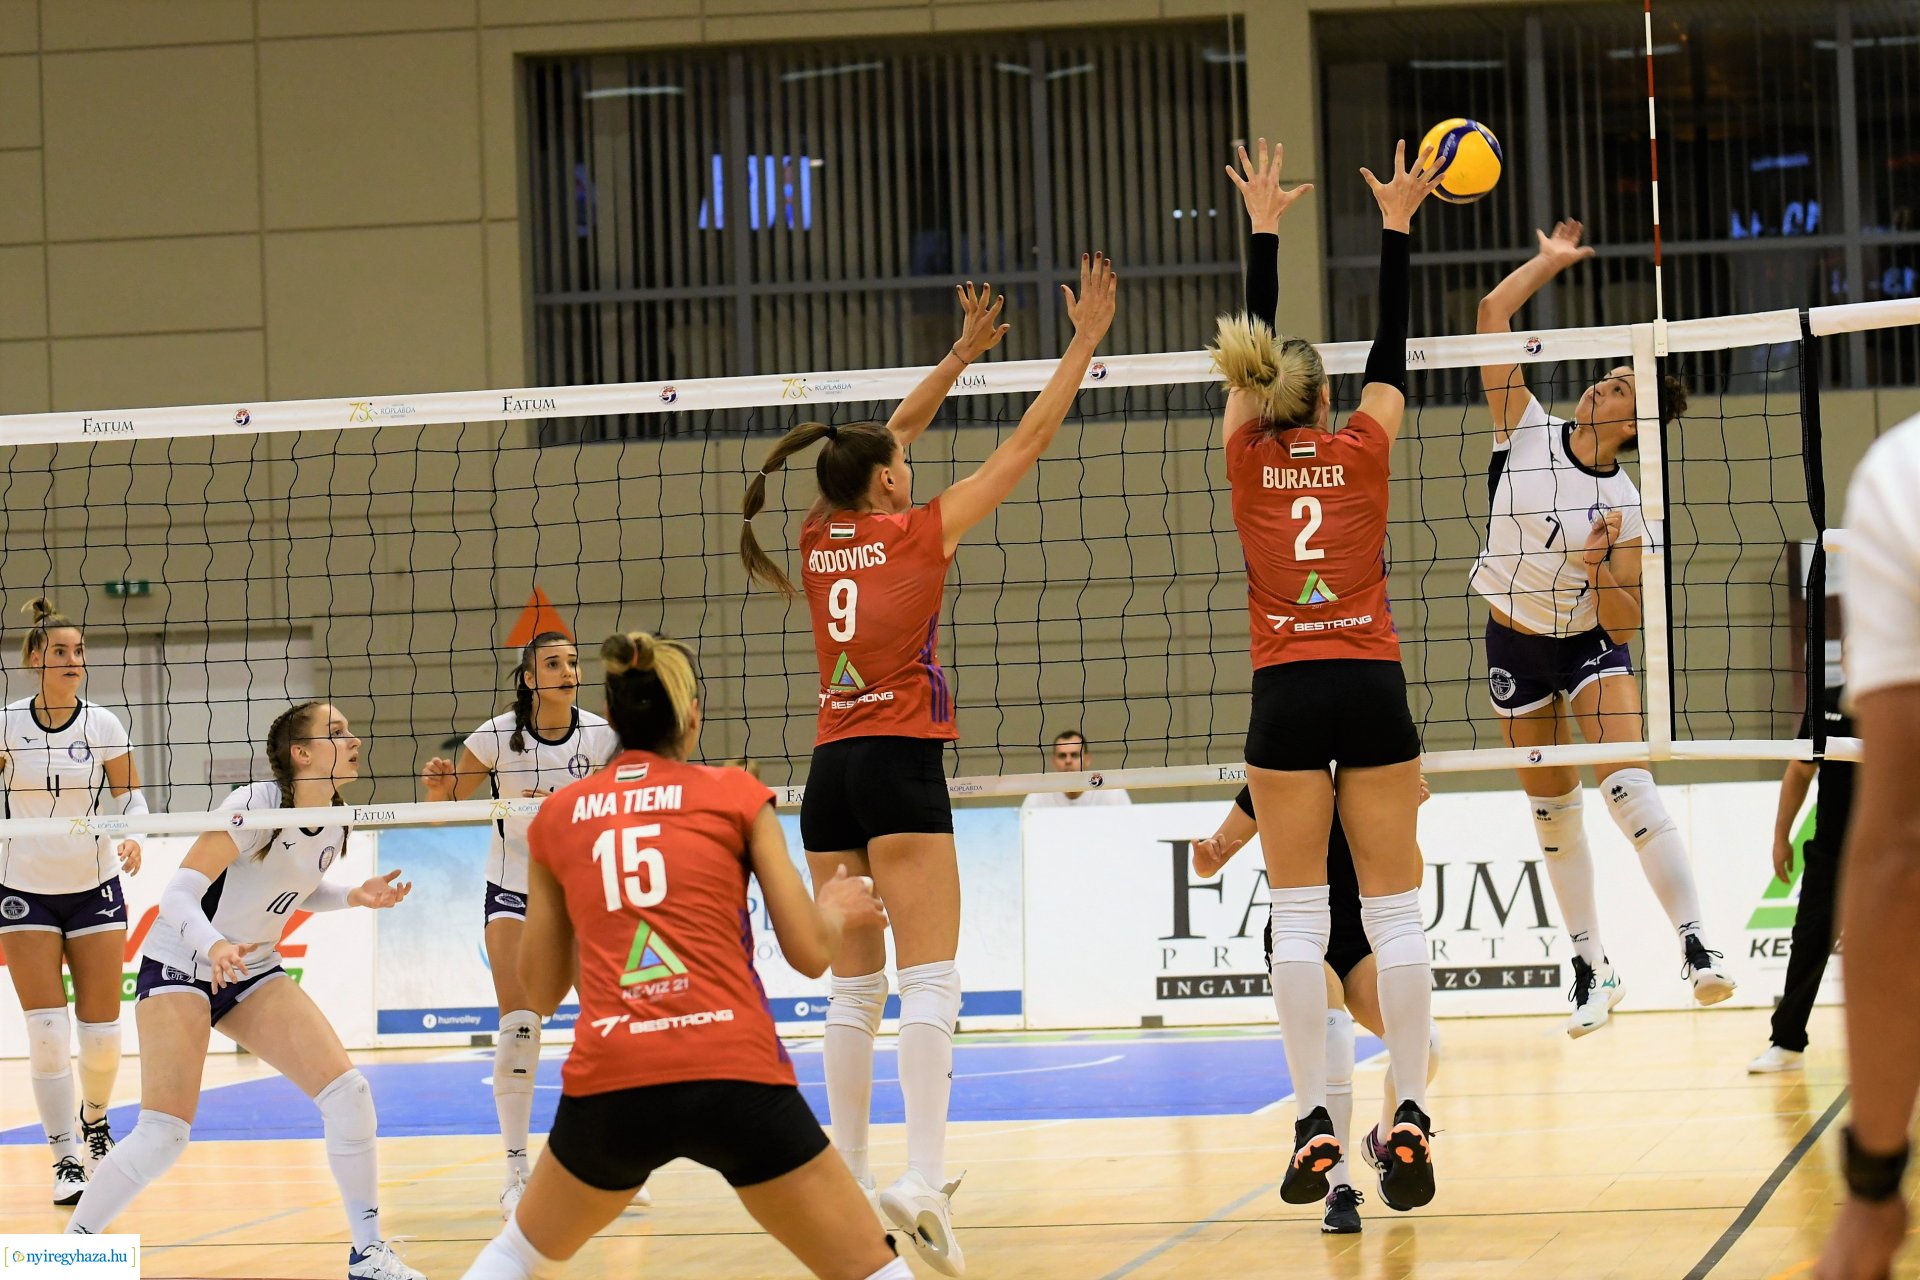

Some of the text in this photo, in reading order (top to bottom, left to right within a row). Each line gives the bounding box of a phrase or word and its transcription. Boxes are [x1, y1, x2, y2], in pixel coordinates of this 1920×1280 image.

[501, 395, 556, 411] FATUM
[81, 417, 134, 433] FATUM
[1262, 464, 1346, 490] BURAZER
[1291, 496, 1325, 562] 2
[1544, 515, 1561, 550] 7
[827, 578, 858, 643] 9
[1294, 614, 1373, 632] BESTRONG
[831, 691, 894, 710] BESRONG
[352, 808, 395, 821] FATUM
[571, 784, 683, 824] ANA TIEMI
[591, 823, 668, 913] 15
[100, 884, 114, 902] 4
[265, 891, 299, 915] 10
[1501, 970, 1555, 986] KFT
[437, 1013, 481, 1025] hunvolley
[629, 1009, 735, 1034] BESTRONG
